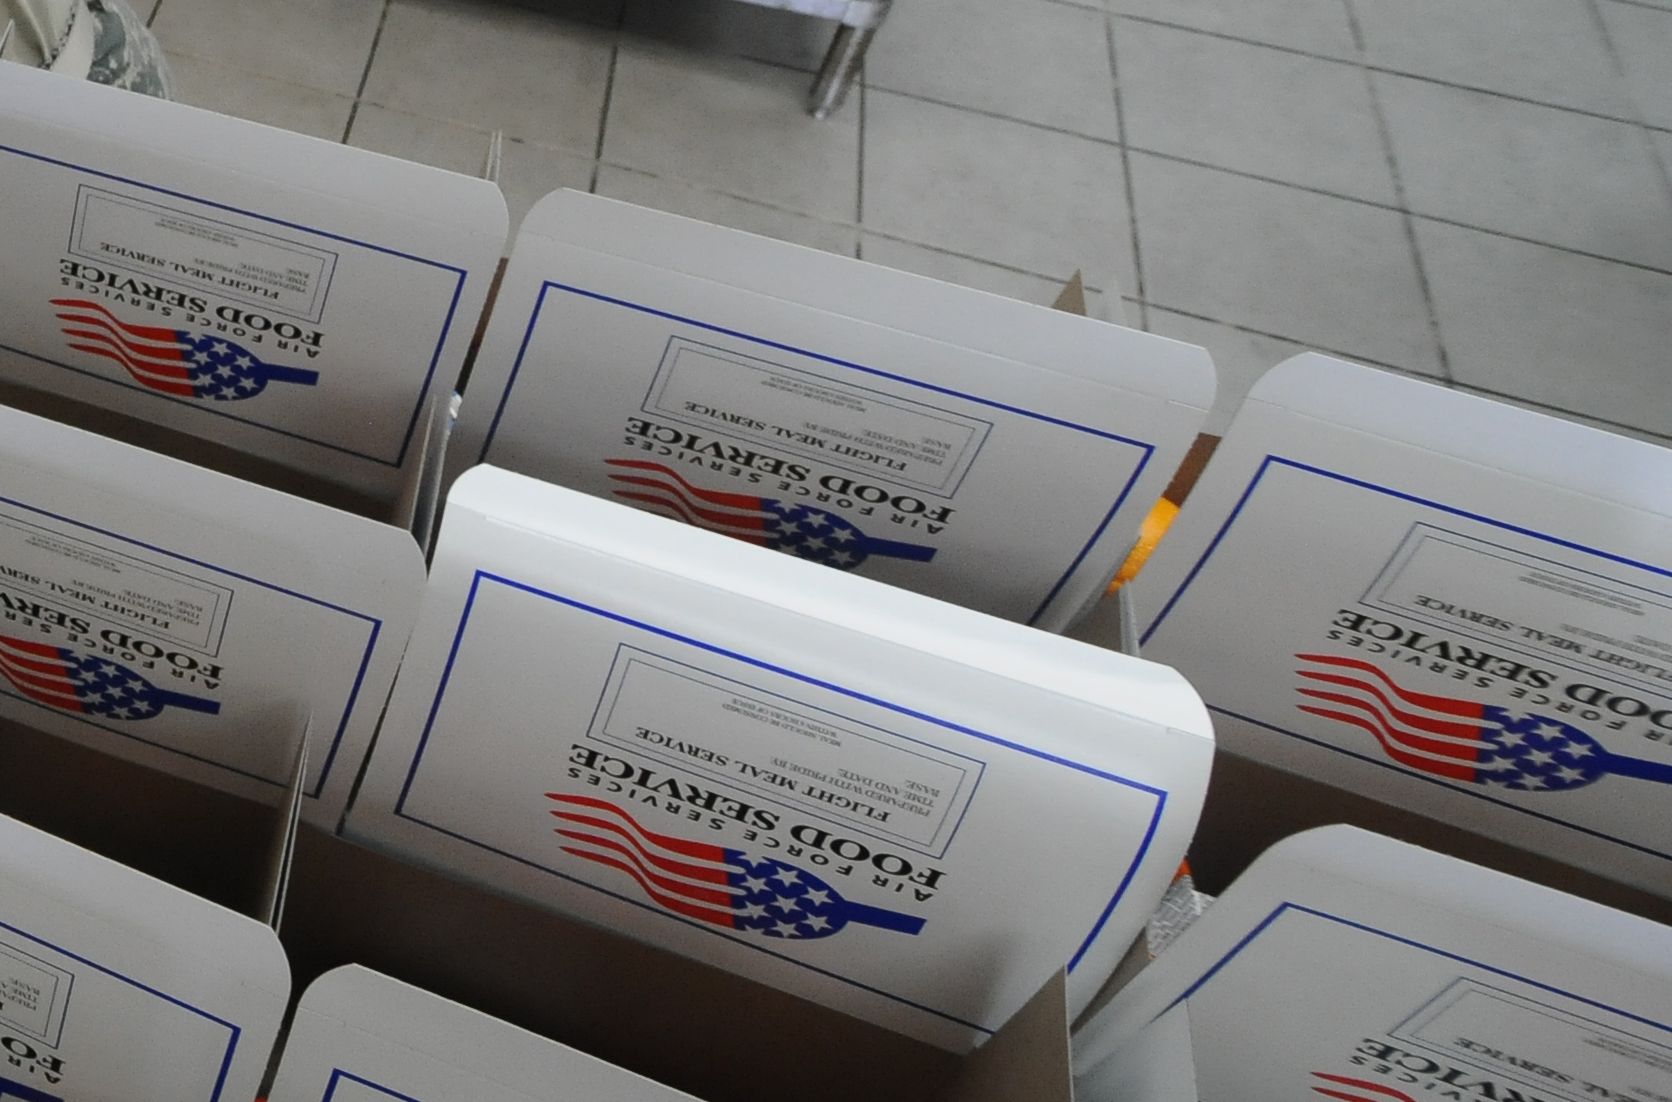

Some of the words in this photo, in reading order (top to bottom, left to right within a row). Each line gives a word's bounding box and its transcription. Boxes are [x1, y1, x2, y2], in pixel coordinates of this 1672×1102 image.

[100, 243, 166, 268] SERVICE
[169, 262, 214, 282] MEAL
[59, 259, 208, 315] SERVICE
[60, 276, 173, 317] SERVICES
[218, 276, 279, 300] FLIGHT
[186, 313, 263, 343] FORCE
[215, 304, 325, 349] FOOD
[277, 340, 320, 360] AIR
[683, 401, 768, 432] SERVICE
[623, 417, 812, 483] SERVICE
[769, 425, 828, 449] MEAL
[622, 435, 764, 484] SERVICES
[830, 443, 908, 472] FLIGHT
[778, 481, 875, 516] FORCE
[817, 473, 957, 525] FOOD
[890, 513, 945, 537] AIR
[45, 581, 96, 605] MEAL
[101, 599, 170, 630] FLIGHT
[1413, 594, 1513, 632] SERVICE
[68, 632, 155, 670] FORCE
[100, 627, 225, 682] FOOD
[1331, 609, 1557, 690] SERVICE
[1519, 626, 1583, 655] MEAL
[1326, 630, 1494, 689] SERVICES
[171, 668, 220, 692] AIR
[1508, 687, 1628, 731] FORCE
[634, 726, 730, 768] SERVICE
[567, 743, 781, 833] SERVICE
[732, 760, 799, 791] MEAL
[788, 763, 828, 783] PRIDE
[828, 776, 866, 795] WITH
[874, 781, 902, 797] AND
[566, 766, 727, 832] SERVICES
[802, 784, 892, 823] FLIGHT
[864, 789, 932, 818] PREPARED
[902, 791, 937, 808] TIME
[743, 829, 854, 877] FORCE
[788, 821, 947, 891] FOOD
[871, 874, 934, 905] AIR
[7, 1054, 62, 1088] AIR
[1453, 1037, 1574, 1084] SERVICE
